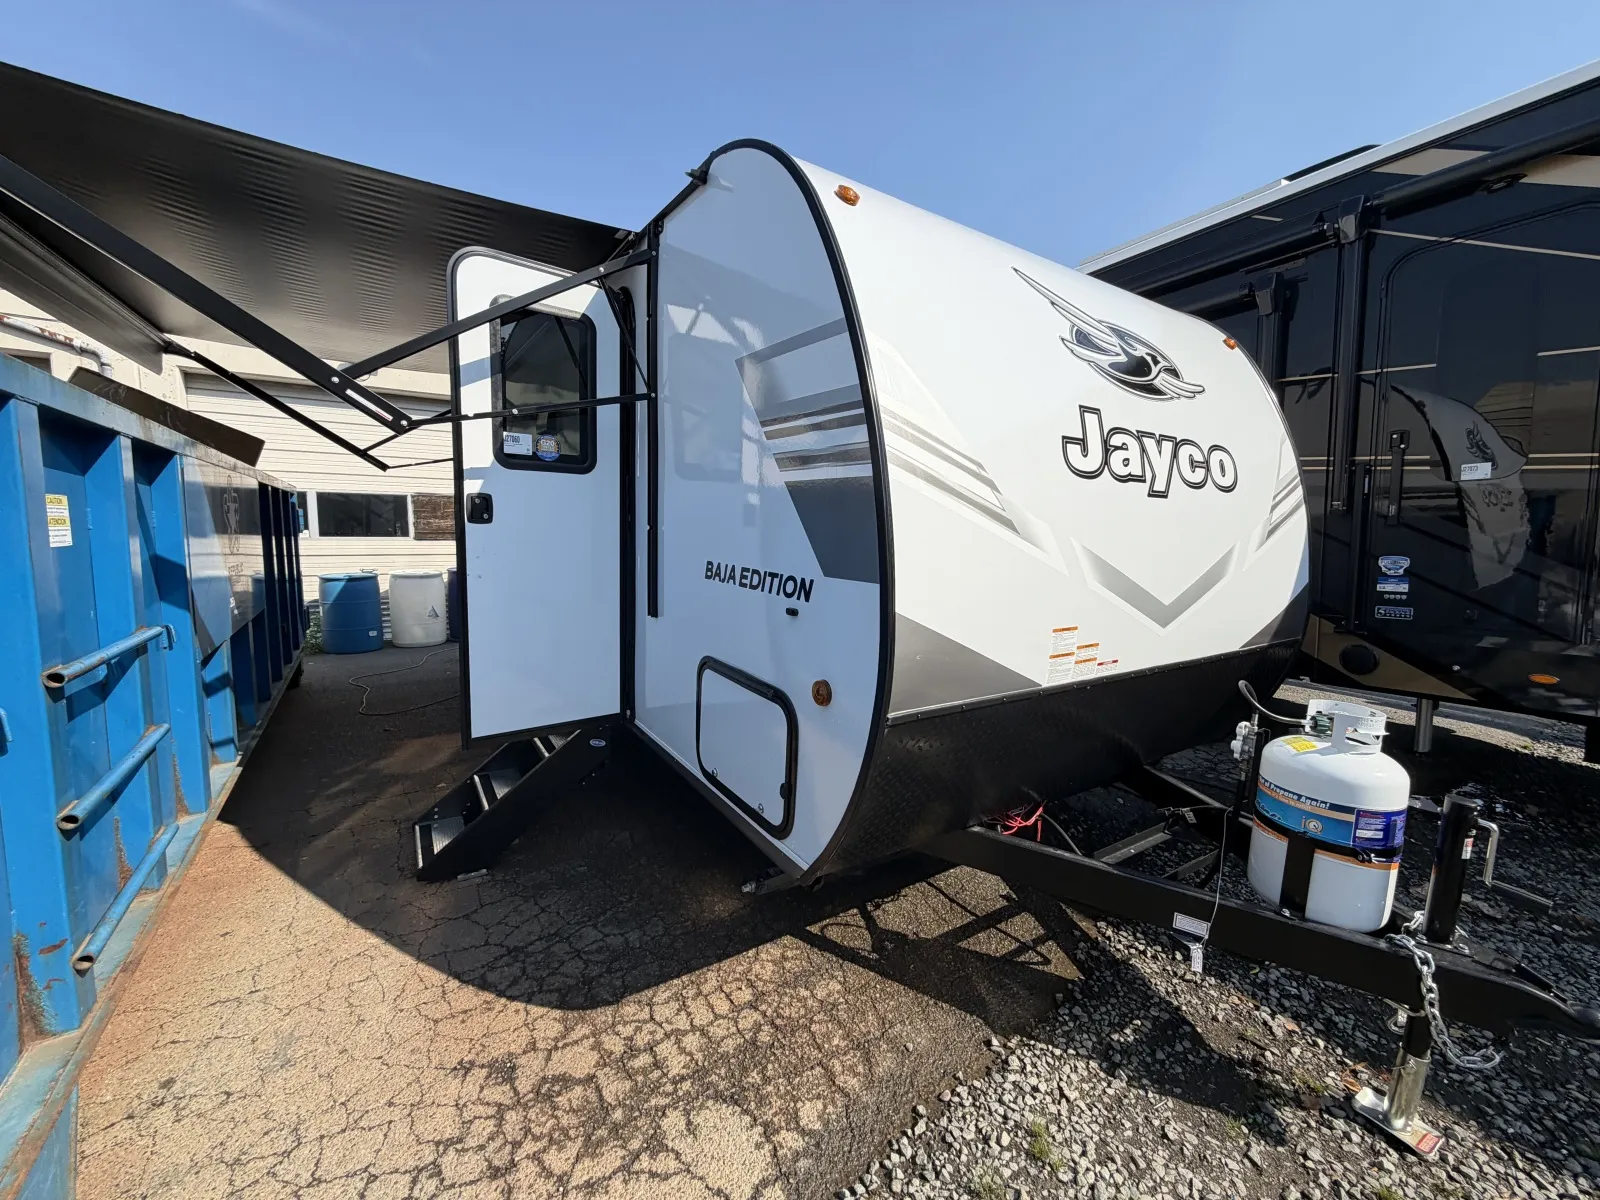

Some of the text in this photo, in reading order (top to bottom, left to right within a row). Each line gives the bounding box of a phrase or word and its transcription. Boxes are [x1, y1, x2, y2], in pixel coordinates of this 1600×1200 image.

[1061, 404, 1239, 499] Jayco
[704, 560, 815, 603] BAJA EDITION
[1270, 784, 1299, 800] Propane
[1300, 795, 1331, 809] Again!
[1301, 816, 1323, 834] iQ
